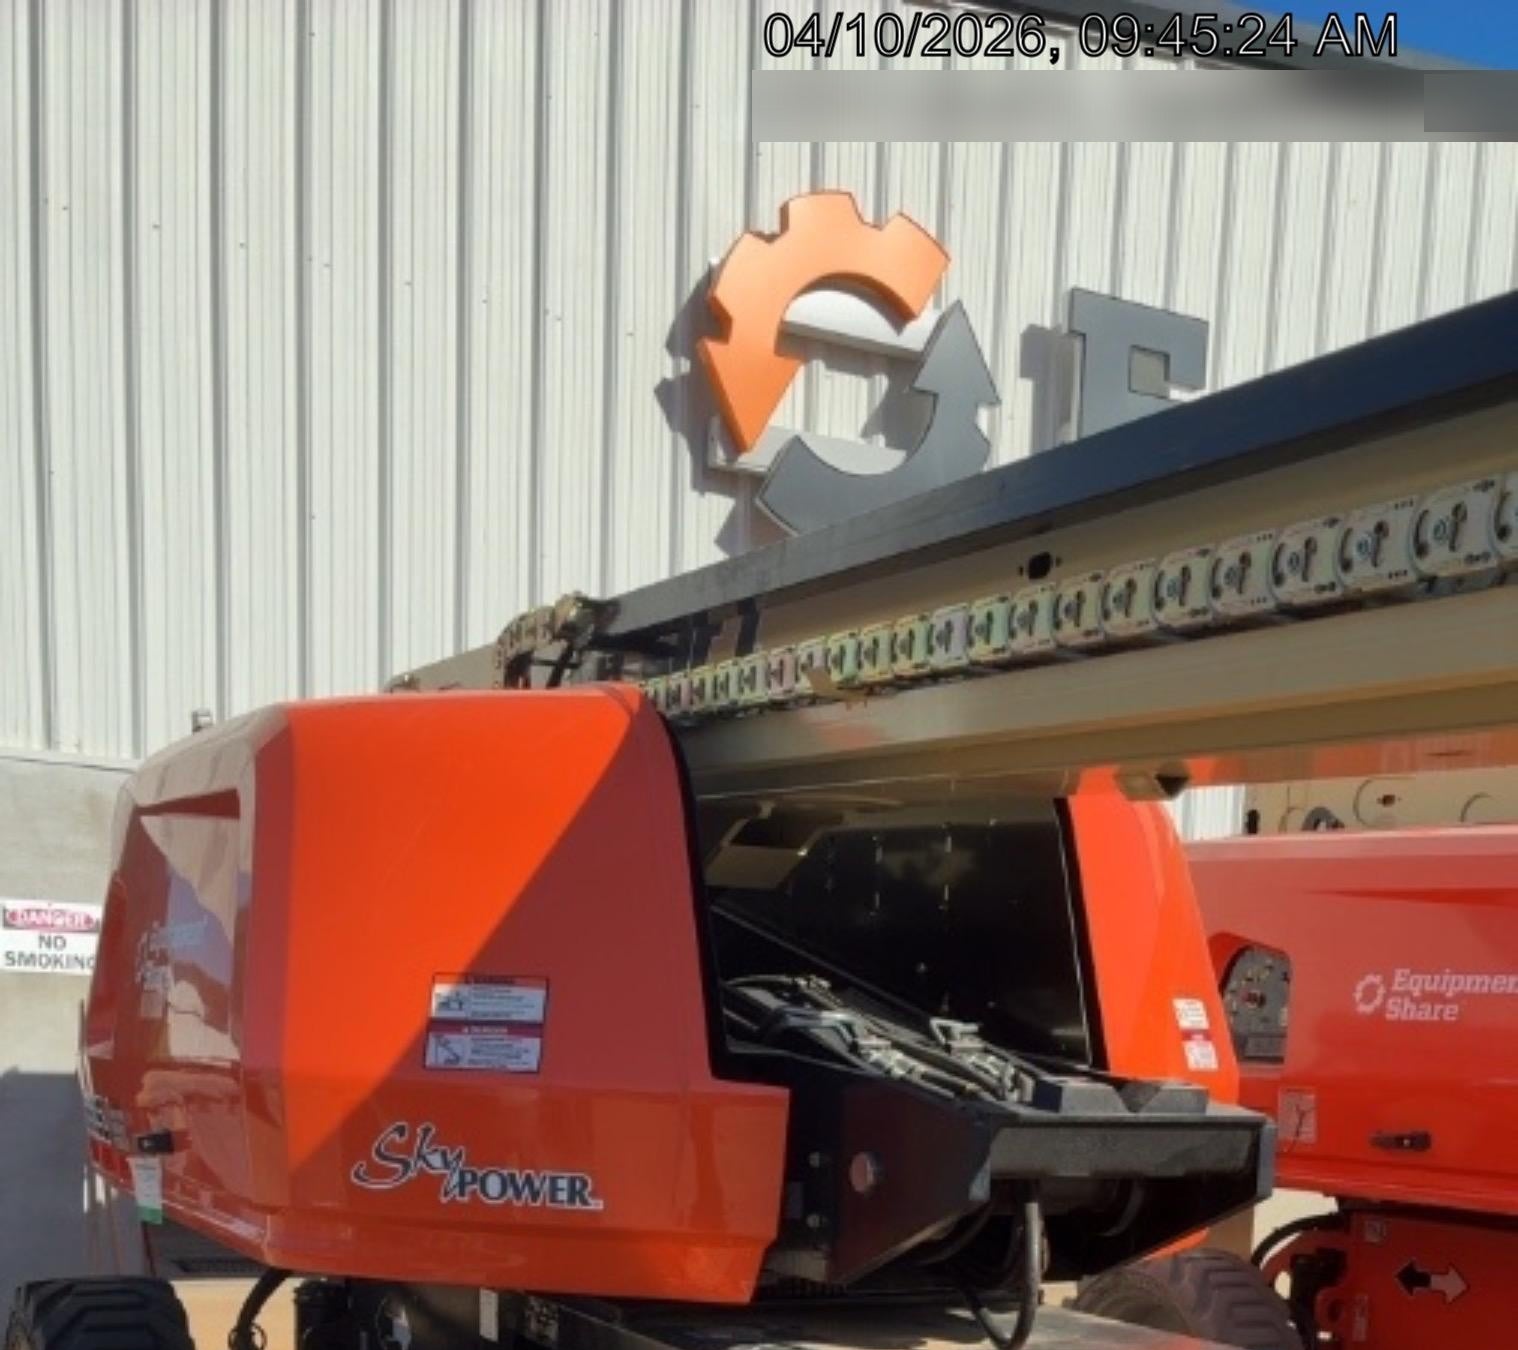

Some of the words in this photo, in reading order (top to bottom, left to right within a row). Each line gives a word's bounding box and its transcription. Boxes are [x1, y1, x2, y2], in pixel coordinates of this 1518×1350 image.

[38, 934, 67, 951] NO
[1385, 996, 1459, 1021] Share
[454, 1167, 599, 1209] POWER
